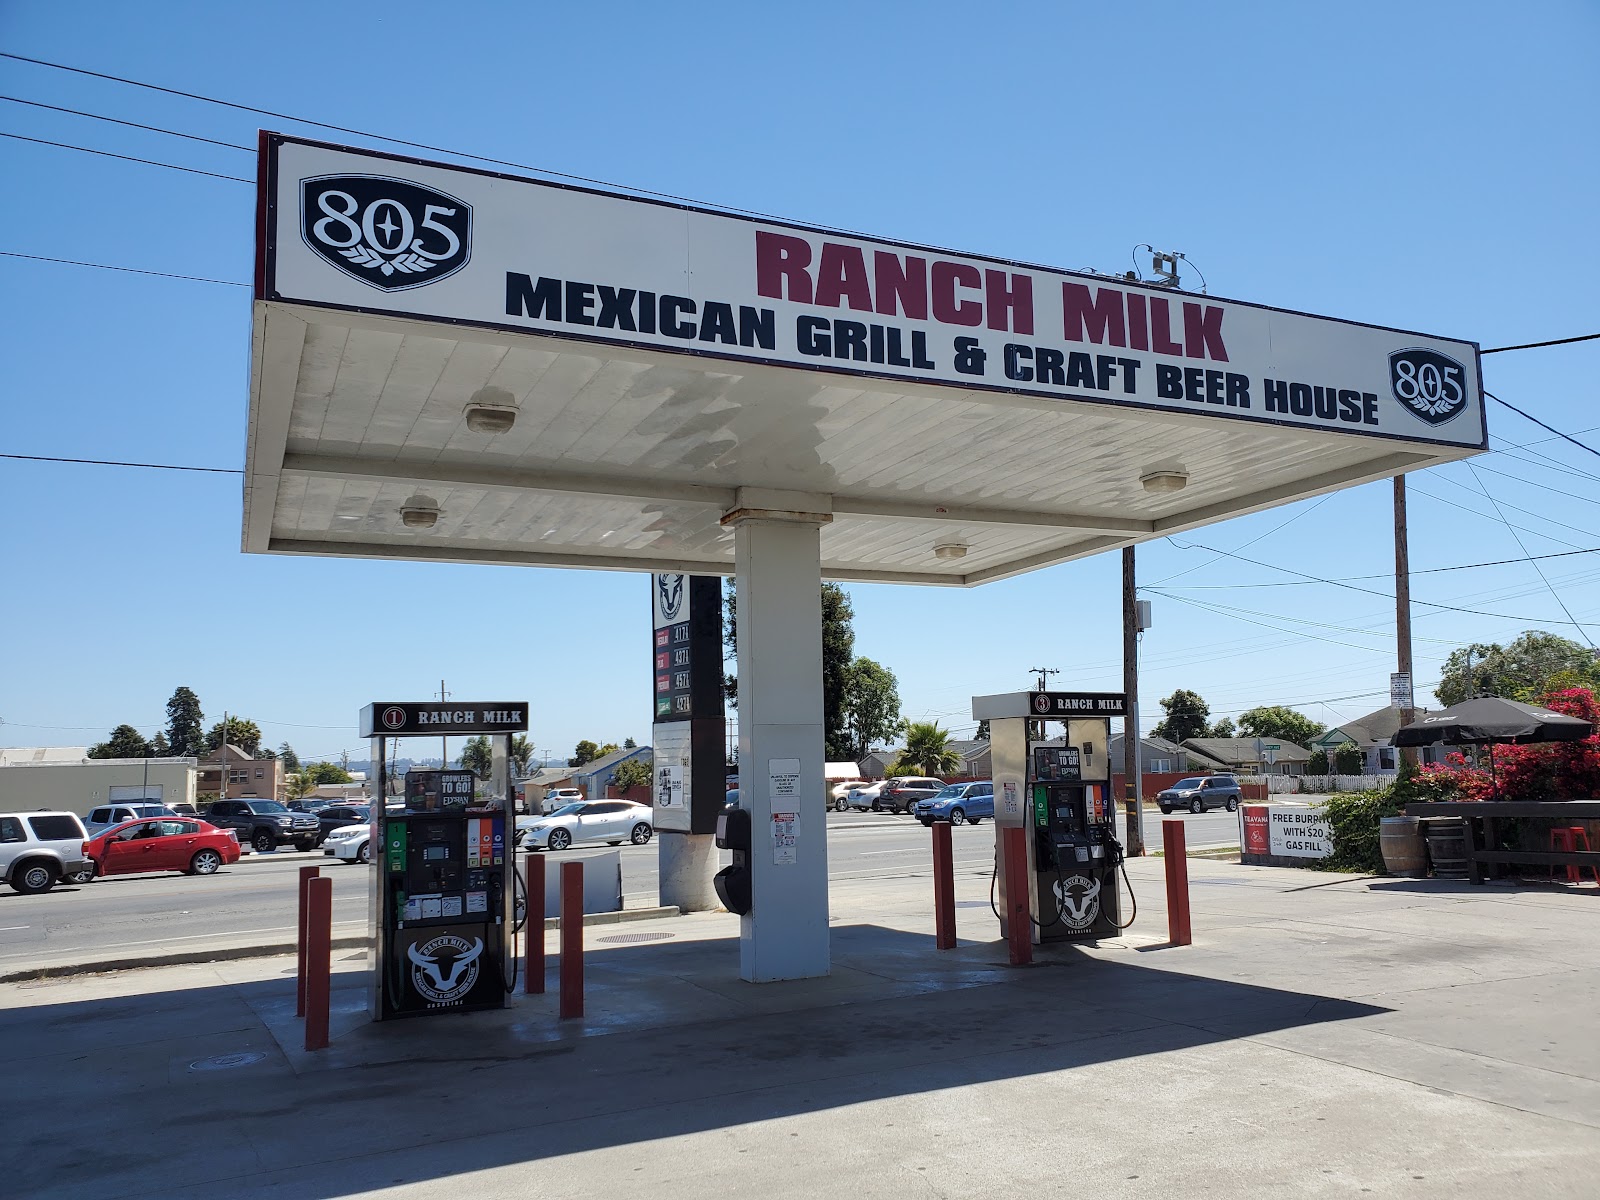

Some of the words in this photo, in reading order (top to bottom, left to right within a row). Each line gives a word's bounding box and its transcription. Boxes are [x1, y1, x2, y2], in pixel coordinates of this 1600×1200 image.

[313, 190, 460, 262] 805
[756, 230, 1035, 336] RANCH
[1062, 282, 1230, 363] MILK
[506, 271, 776, 351] MEXICAN
[797, 315, 936, 371] GRILL
[954, 336, 987, 377] &
[1004, 343, 1142, 395] CRAFT
[1156, 363, 1251, 409] BEER
[1264, 378, 1379, 426] HOUSE
[1396, 359, 1463, 405] 805
[1057, 699, 1093, 710] RANCH
[1098, 699, 1123, 710] MILK
[390, 710, 399, 725] 1
[418, 710, 475, 724] RANCH
[483, 710, 522, 723] MILK
[1059, 757, 1067, 765] TO
[1068, 757, 1079, 765] GO!
[441, 783, 453, 793] TO
[456, 782, 471, 793] GO!
[1272, 813, 1293, 823] FREE
[1296, 814, 1332, 824] BURR
[1283, 827, 1306, 837] WITH
[1307, 828, 1324, 838] $20
[1286, 840, 1303, 850] GAS
[1304, 841, 1322, 851] FILL
